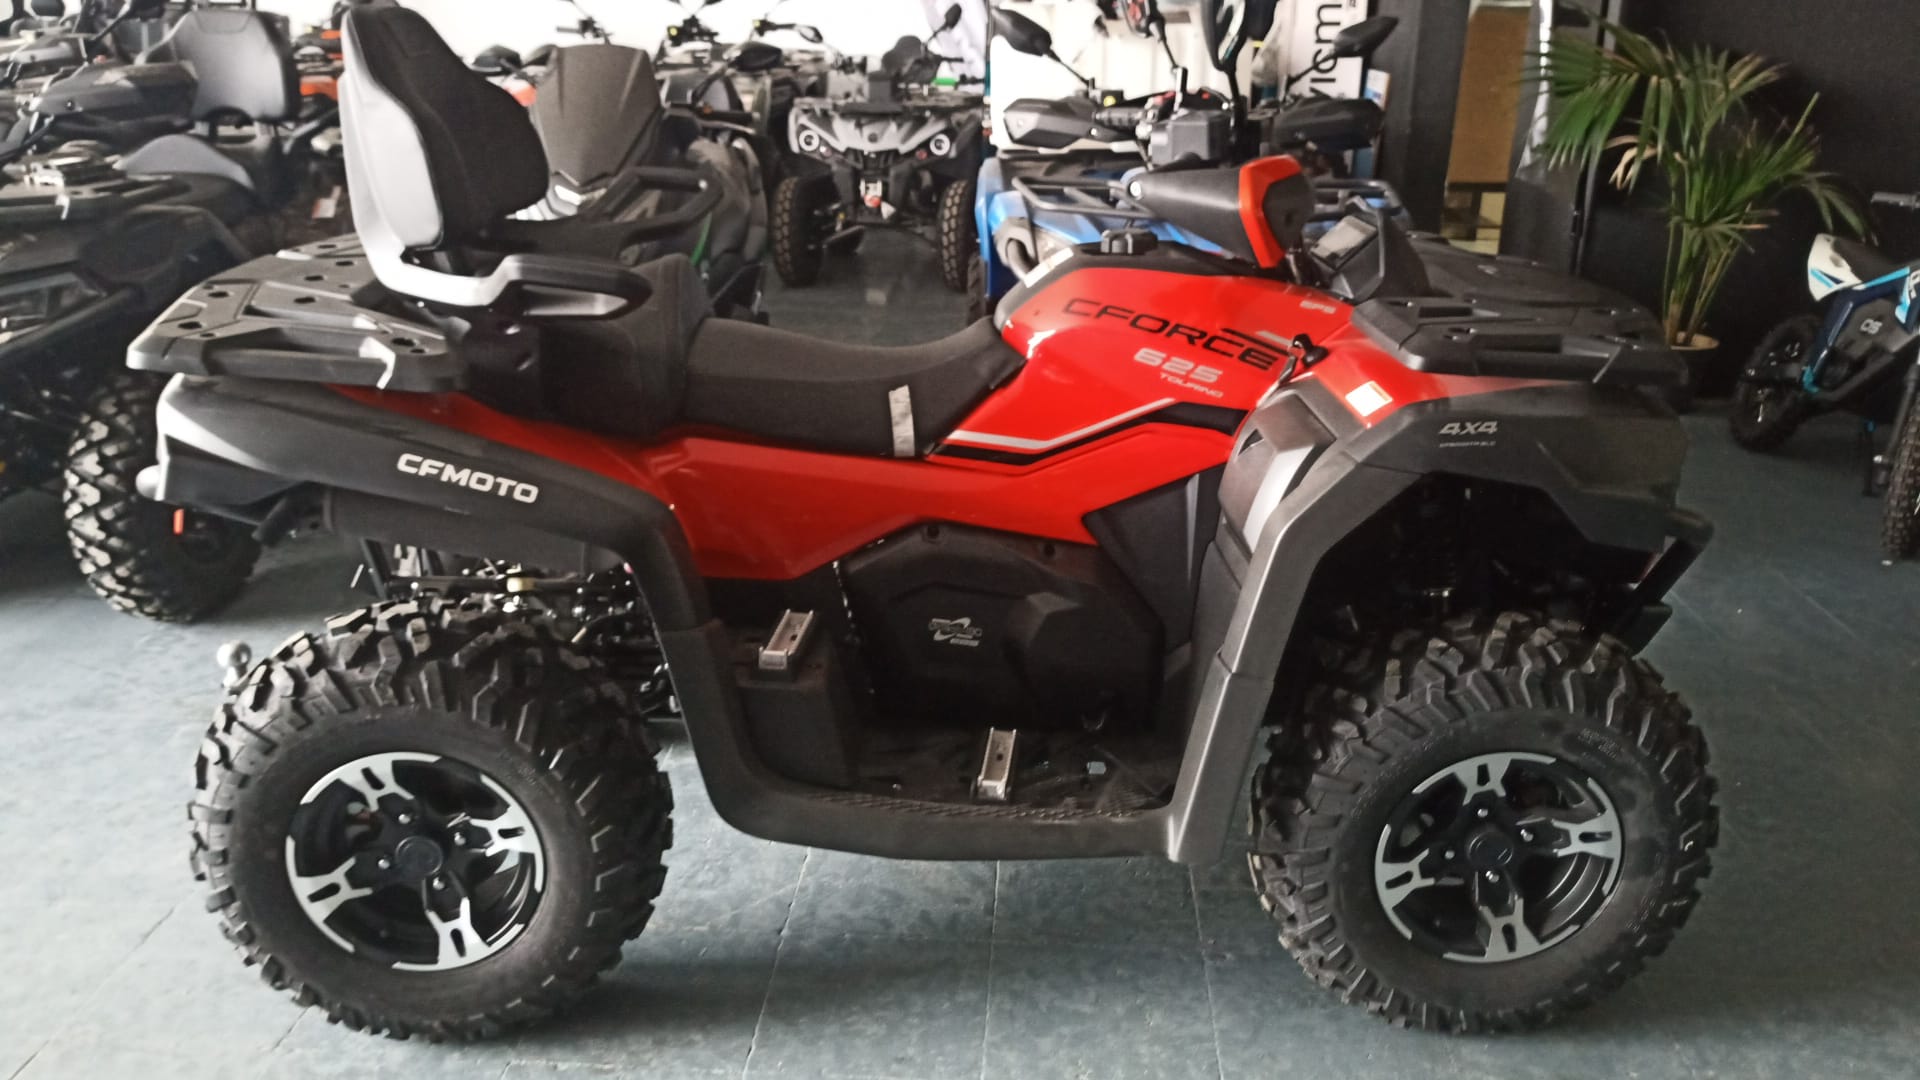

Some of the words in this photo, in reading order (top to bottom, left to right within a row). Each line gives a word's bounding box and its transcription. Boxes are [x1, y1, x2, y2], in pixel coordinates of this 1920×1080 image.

[1063, 298, 1279, 371] CFORCE
[1134, 347, 1223, 383] 625
[397, 453, 539, 503] CFMOTO
